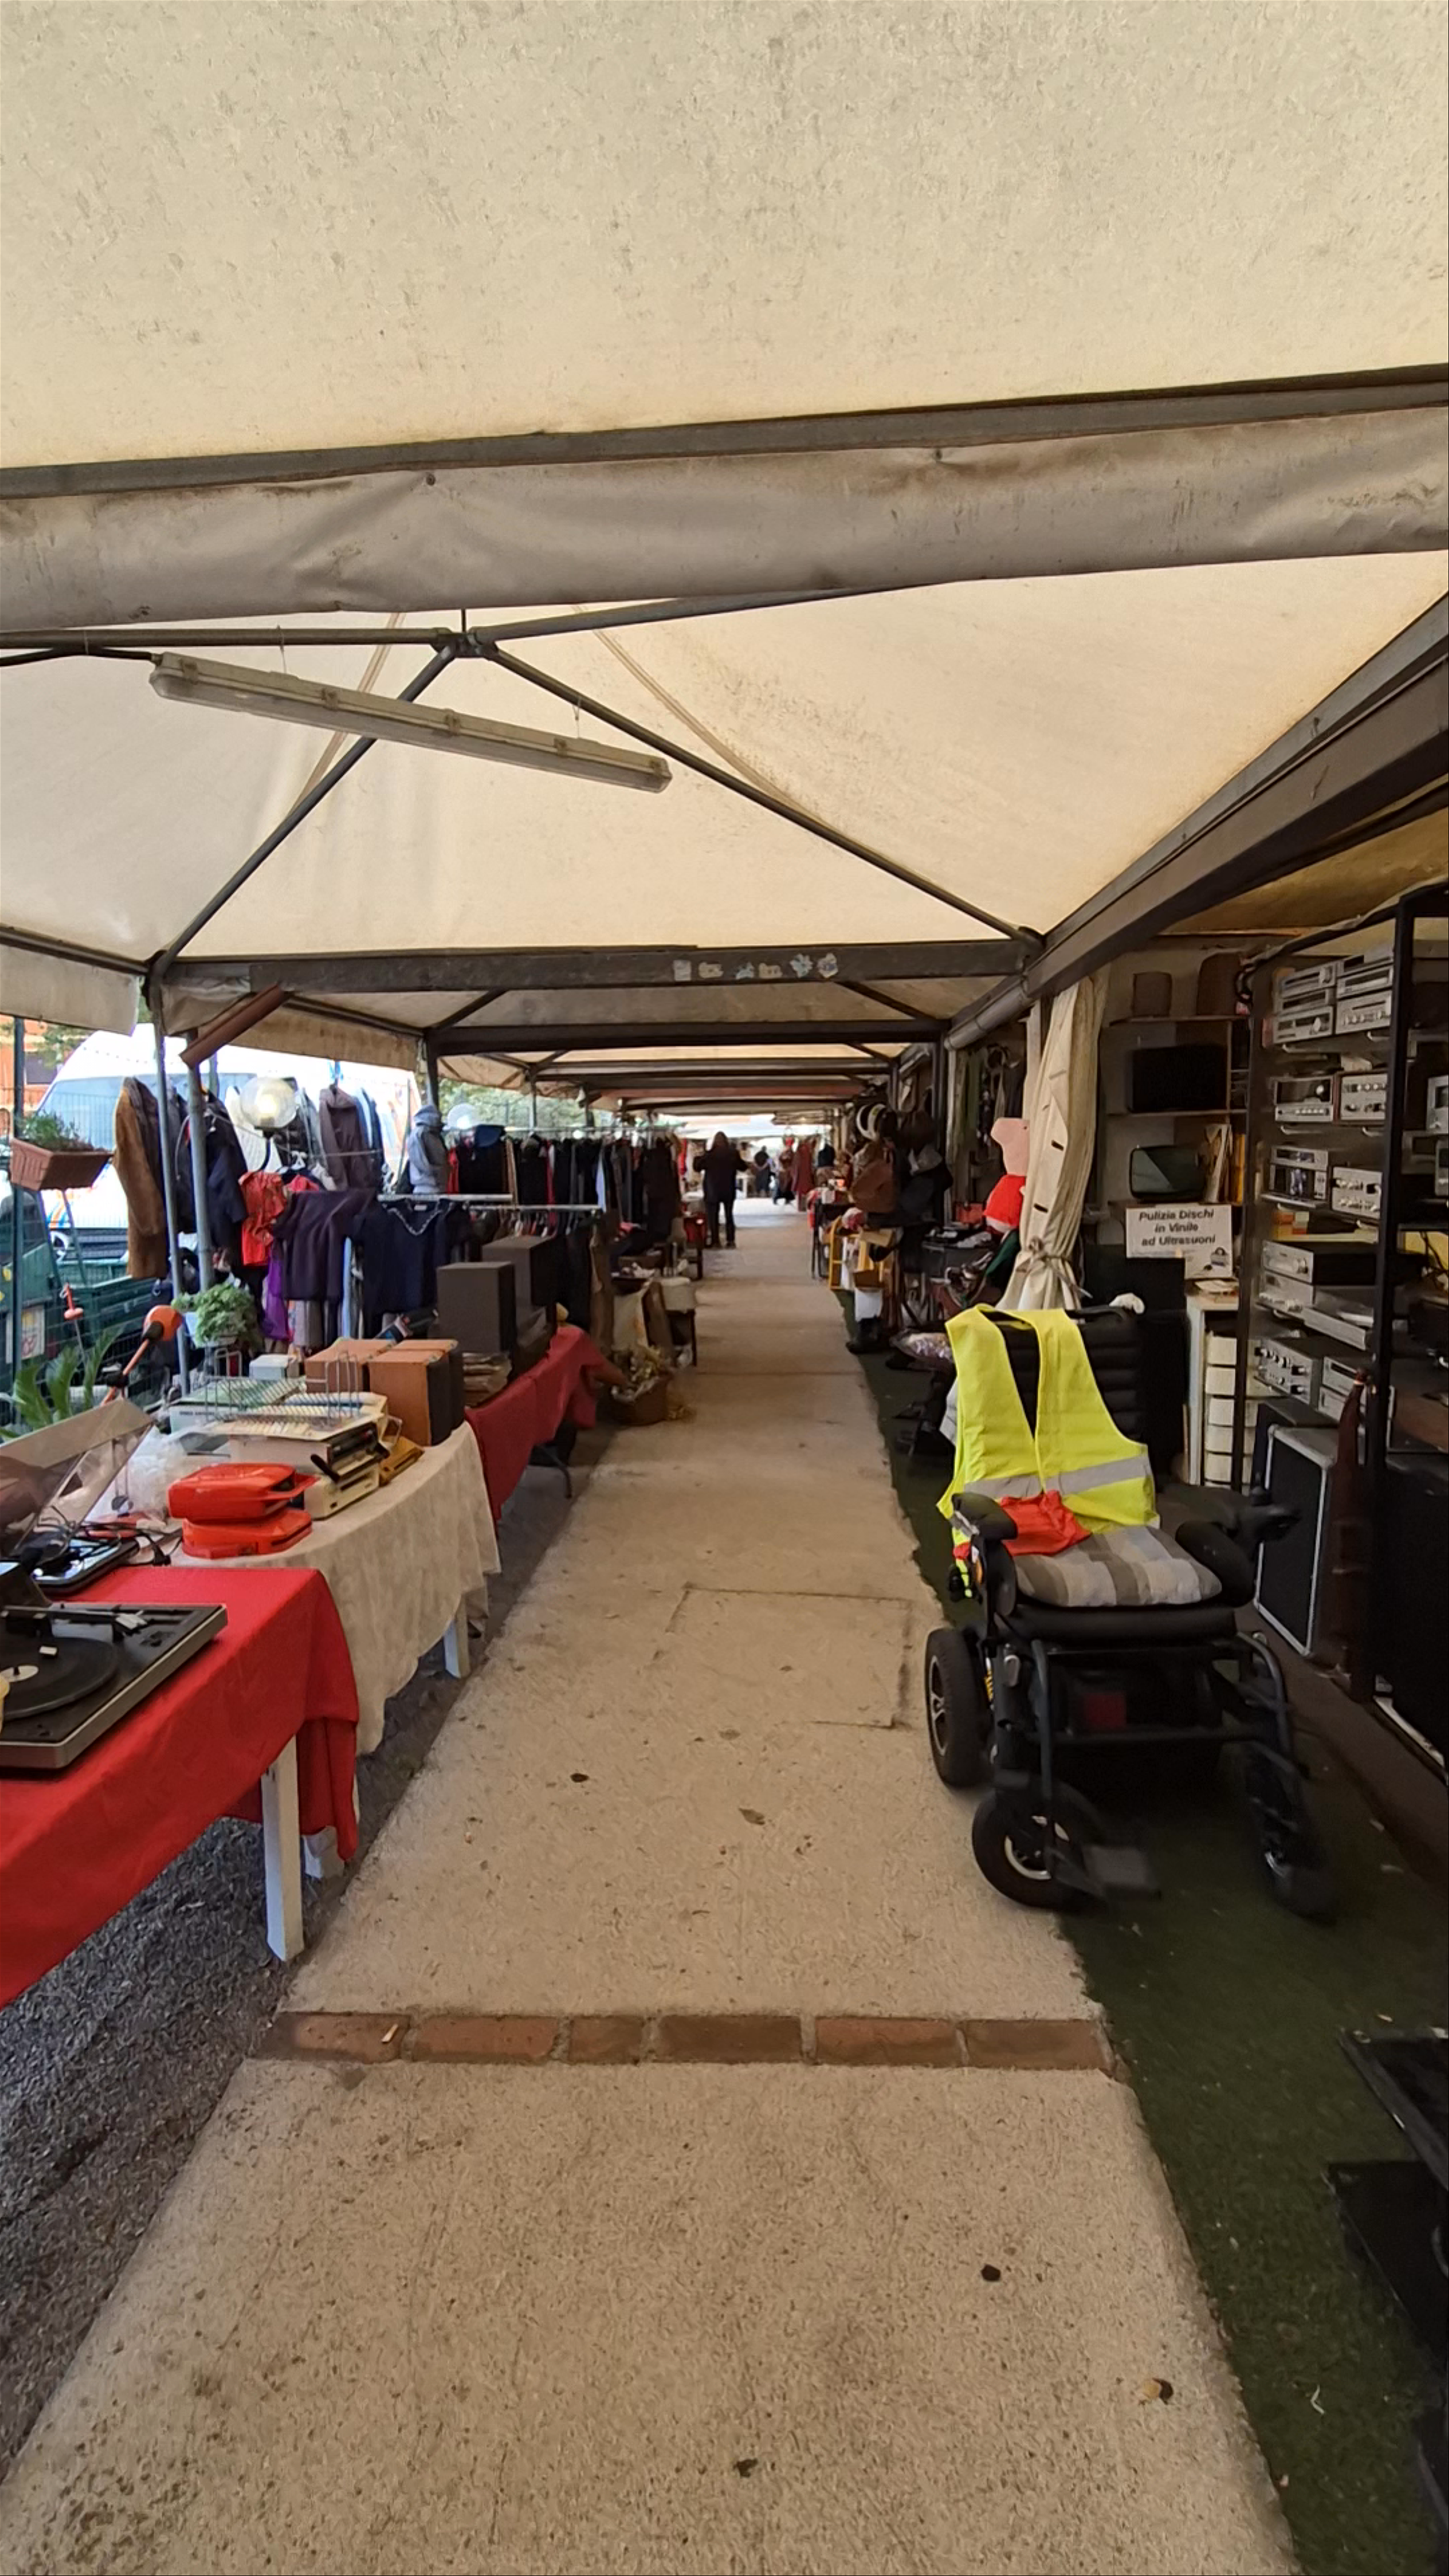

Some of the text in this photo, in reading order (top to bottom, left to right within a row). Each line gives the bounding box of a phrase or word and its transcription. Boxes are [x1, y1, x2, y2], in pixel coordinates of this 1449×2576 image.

[1139, 1209, 1214, 1221] Pulizia Dischi
[1155, 1223, 1199, 1233] in Vinile
[1142, 1234, 1216, 1246] ad Ultrasuoni
